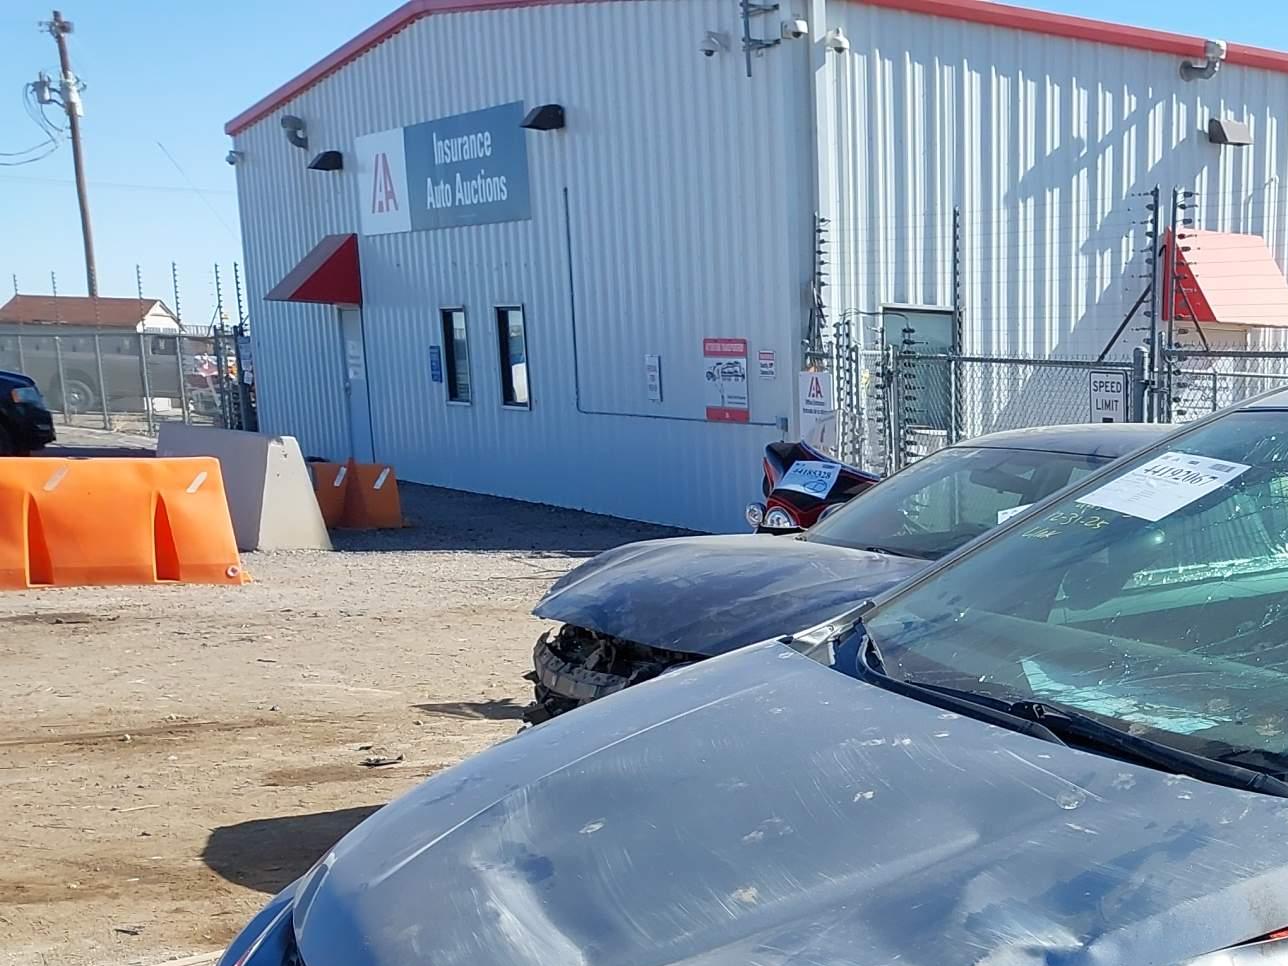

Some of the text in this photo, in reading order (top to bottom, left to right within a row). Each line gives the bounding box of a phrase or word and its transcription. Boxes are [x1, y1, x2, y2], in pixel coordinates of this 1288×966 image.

[433, 131, 492, 165] Insurance
[427, 169, 508, 210] Auto Auctions
[1092, 380, 1122, 393] SPEED
[1096, 400, 1119, 412] LIMIT
[1144, 464, 1218, 486] 44192067
